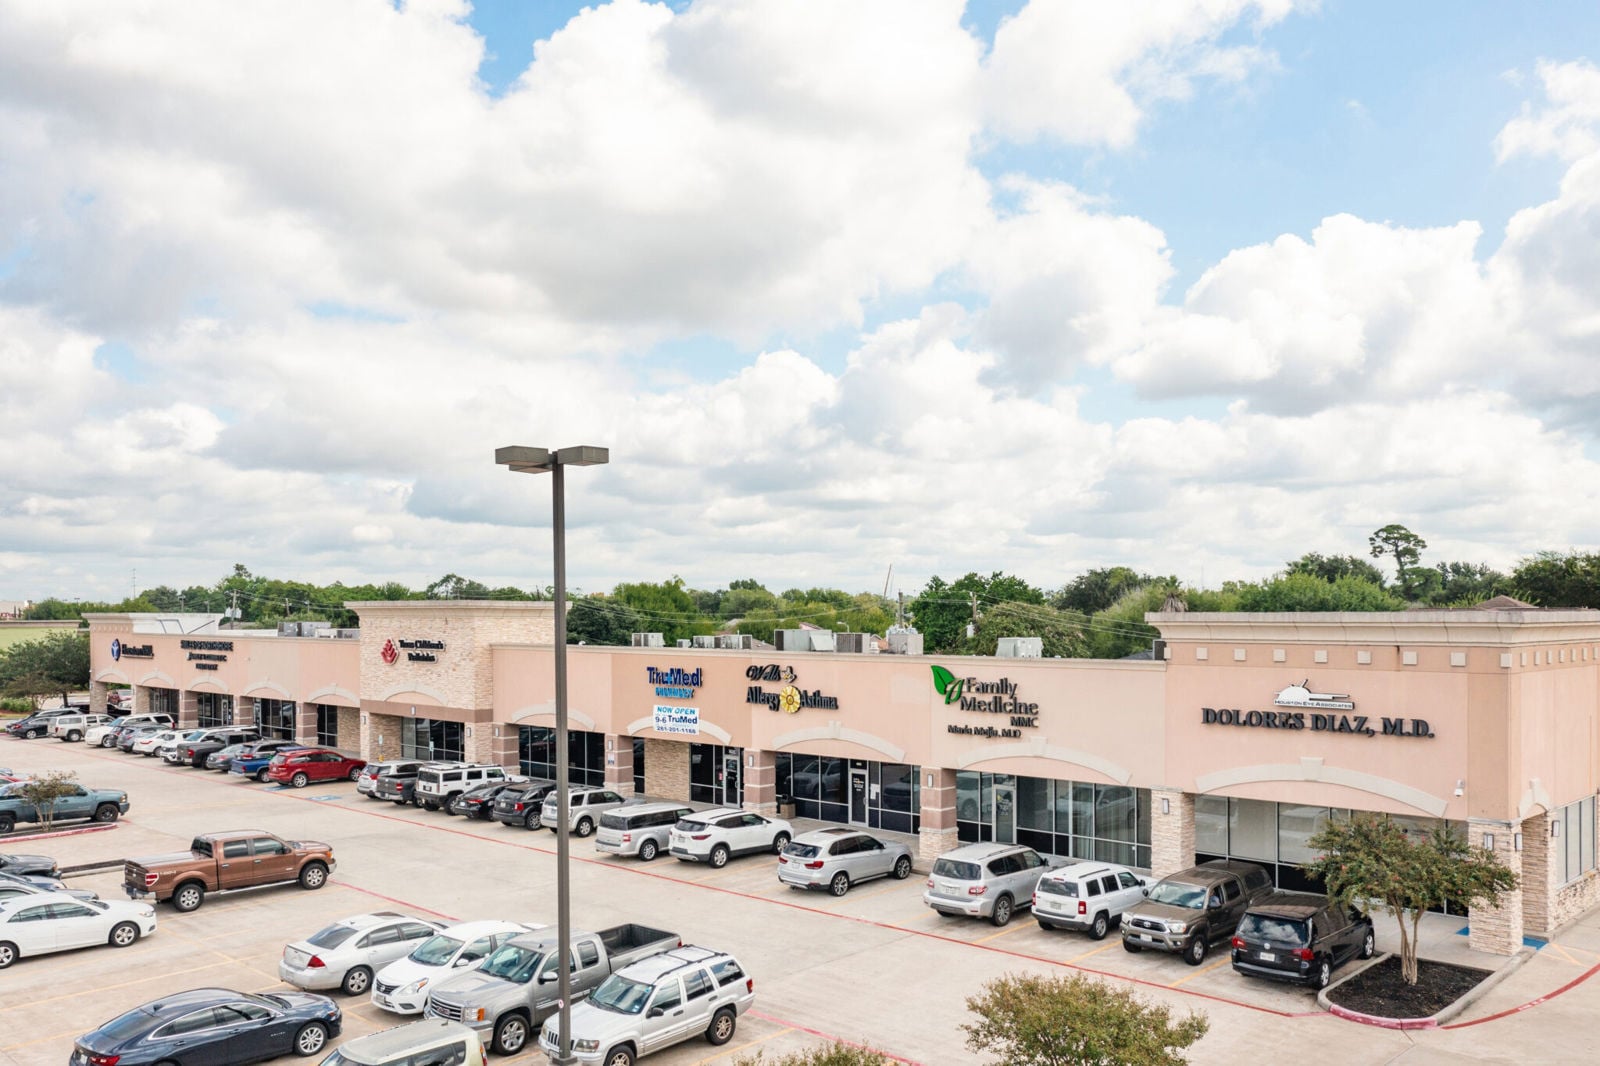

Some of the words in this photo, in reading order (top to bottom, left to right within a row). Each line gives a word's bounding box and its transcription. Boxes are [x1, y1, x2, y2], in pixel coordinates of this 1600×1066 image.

[646, 666, 702, 687] TruMed
[966, 677, 1018, 699] Family
[746, 686, 780, 712] Allergy
[800, 690, 838, 710] Asthma
[960, 696, 1039, 715] Medicine
[668, 715, 698, 724] TruMed
[1010, 716, 1039, 728] MMC
[1201, 708, 1304, 730] DOLORES
[1310, 714, 1375, 737] DIAZ,
[1381, 717, 1435, 738] M.D.
